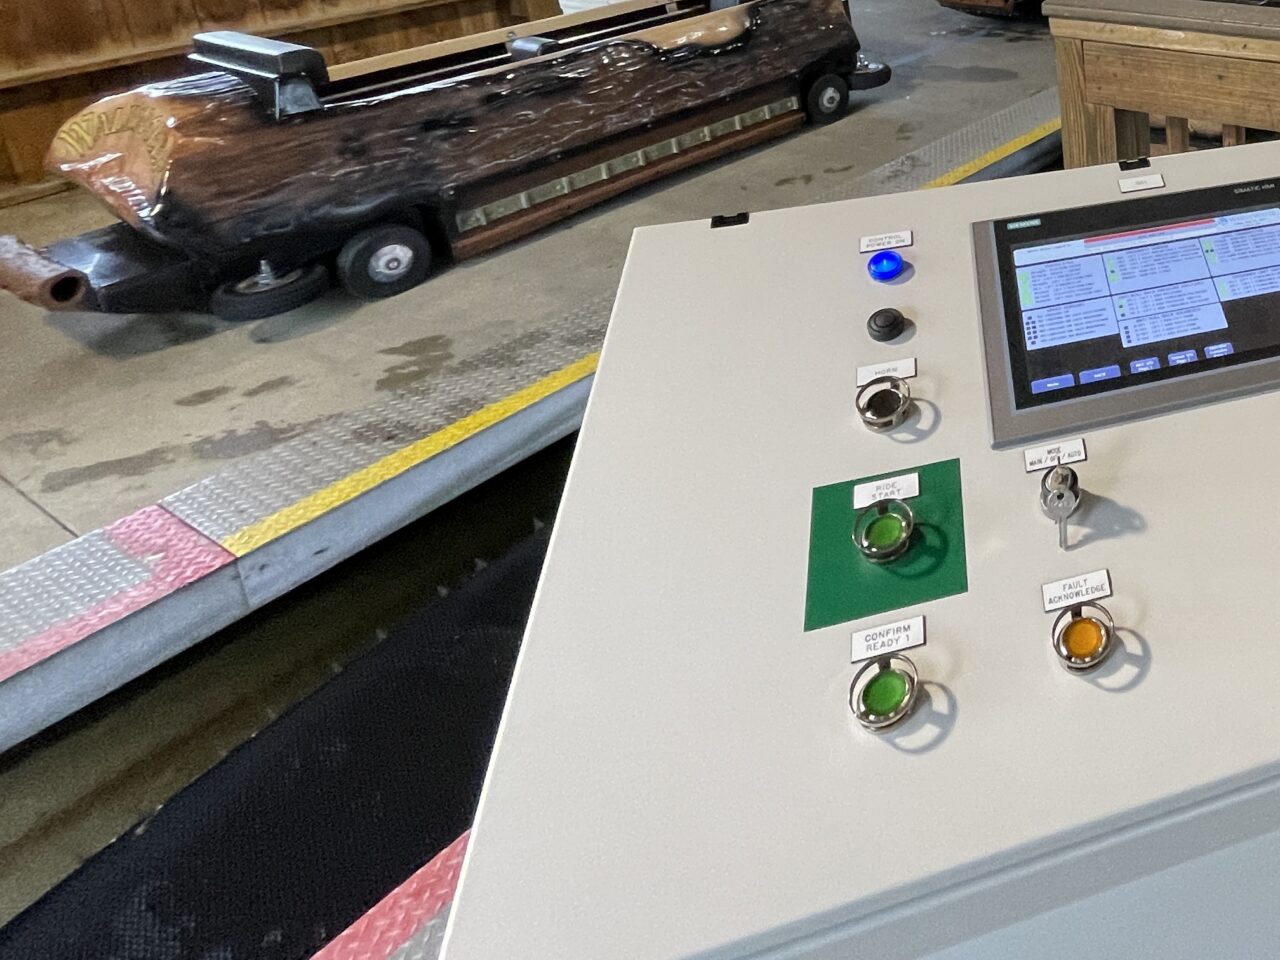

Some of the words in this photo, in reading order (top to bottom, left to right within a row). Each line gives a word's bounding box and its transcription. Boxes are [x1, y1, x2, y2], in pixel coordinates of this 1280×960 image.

[875, 481, 898, 492] RIDE
[871, 489, 902, 501] START
[1062, 578, 1088, 592] FAULT
[1048, 583, 1106, 605] ACKNOWLEDGE
[864, 624, 911, 643] CONFIRM
[866, 637, 901, 653] READY
